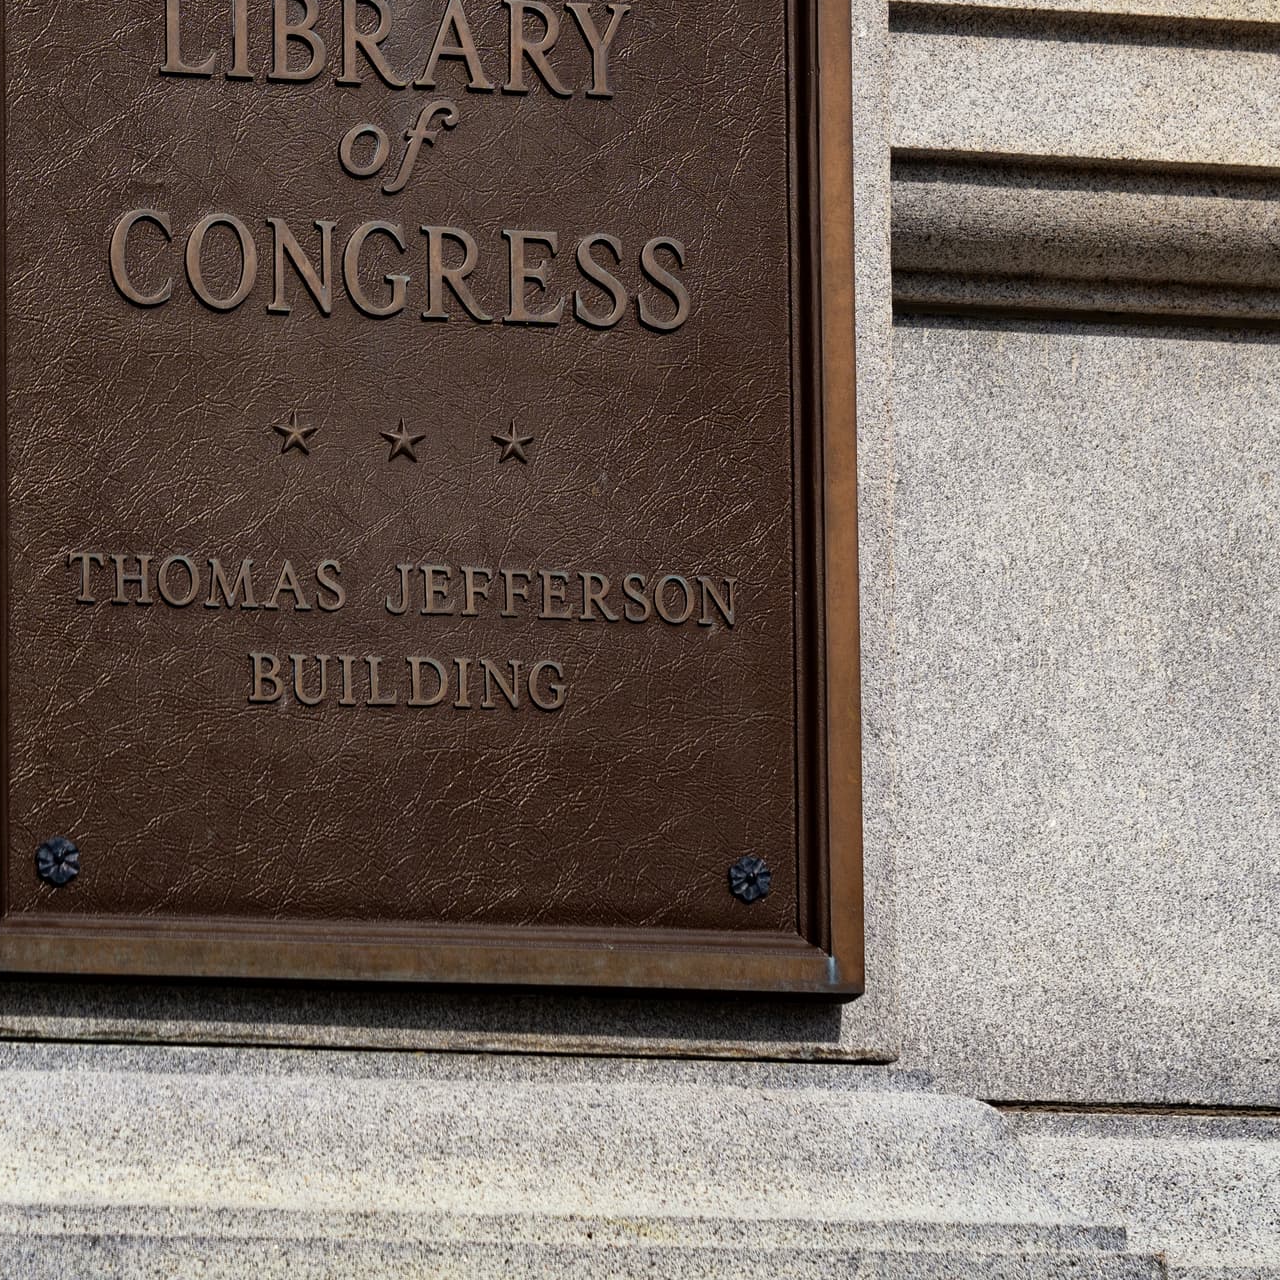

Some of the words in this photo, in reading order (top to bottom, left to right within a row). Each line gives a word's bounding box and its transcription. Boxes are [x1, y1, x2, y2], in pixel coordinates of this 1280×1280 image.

[338, 99, 460, 195] of
[109, 208, 693, 332] CONGRESS
[67, 551, 346, 612] THOMAS
[384, 562, 738, 626] JEFFERSON
[248, 651, 569, 711] BUILDING
